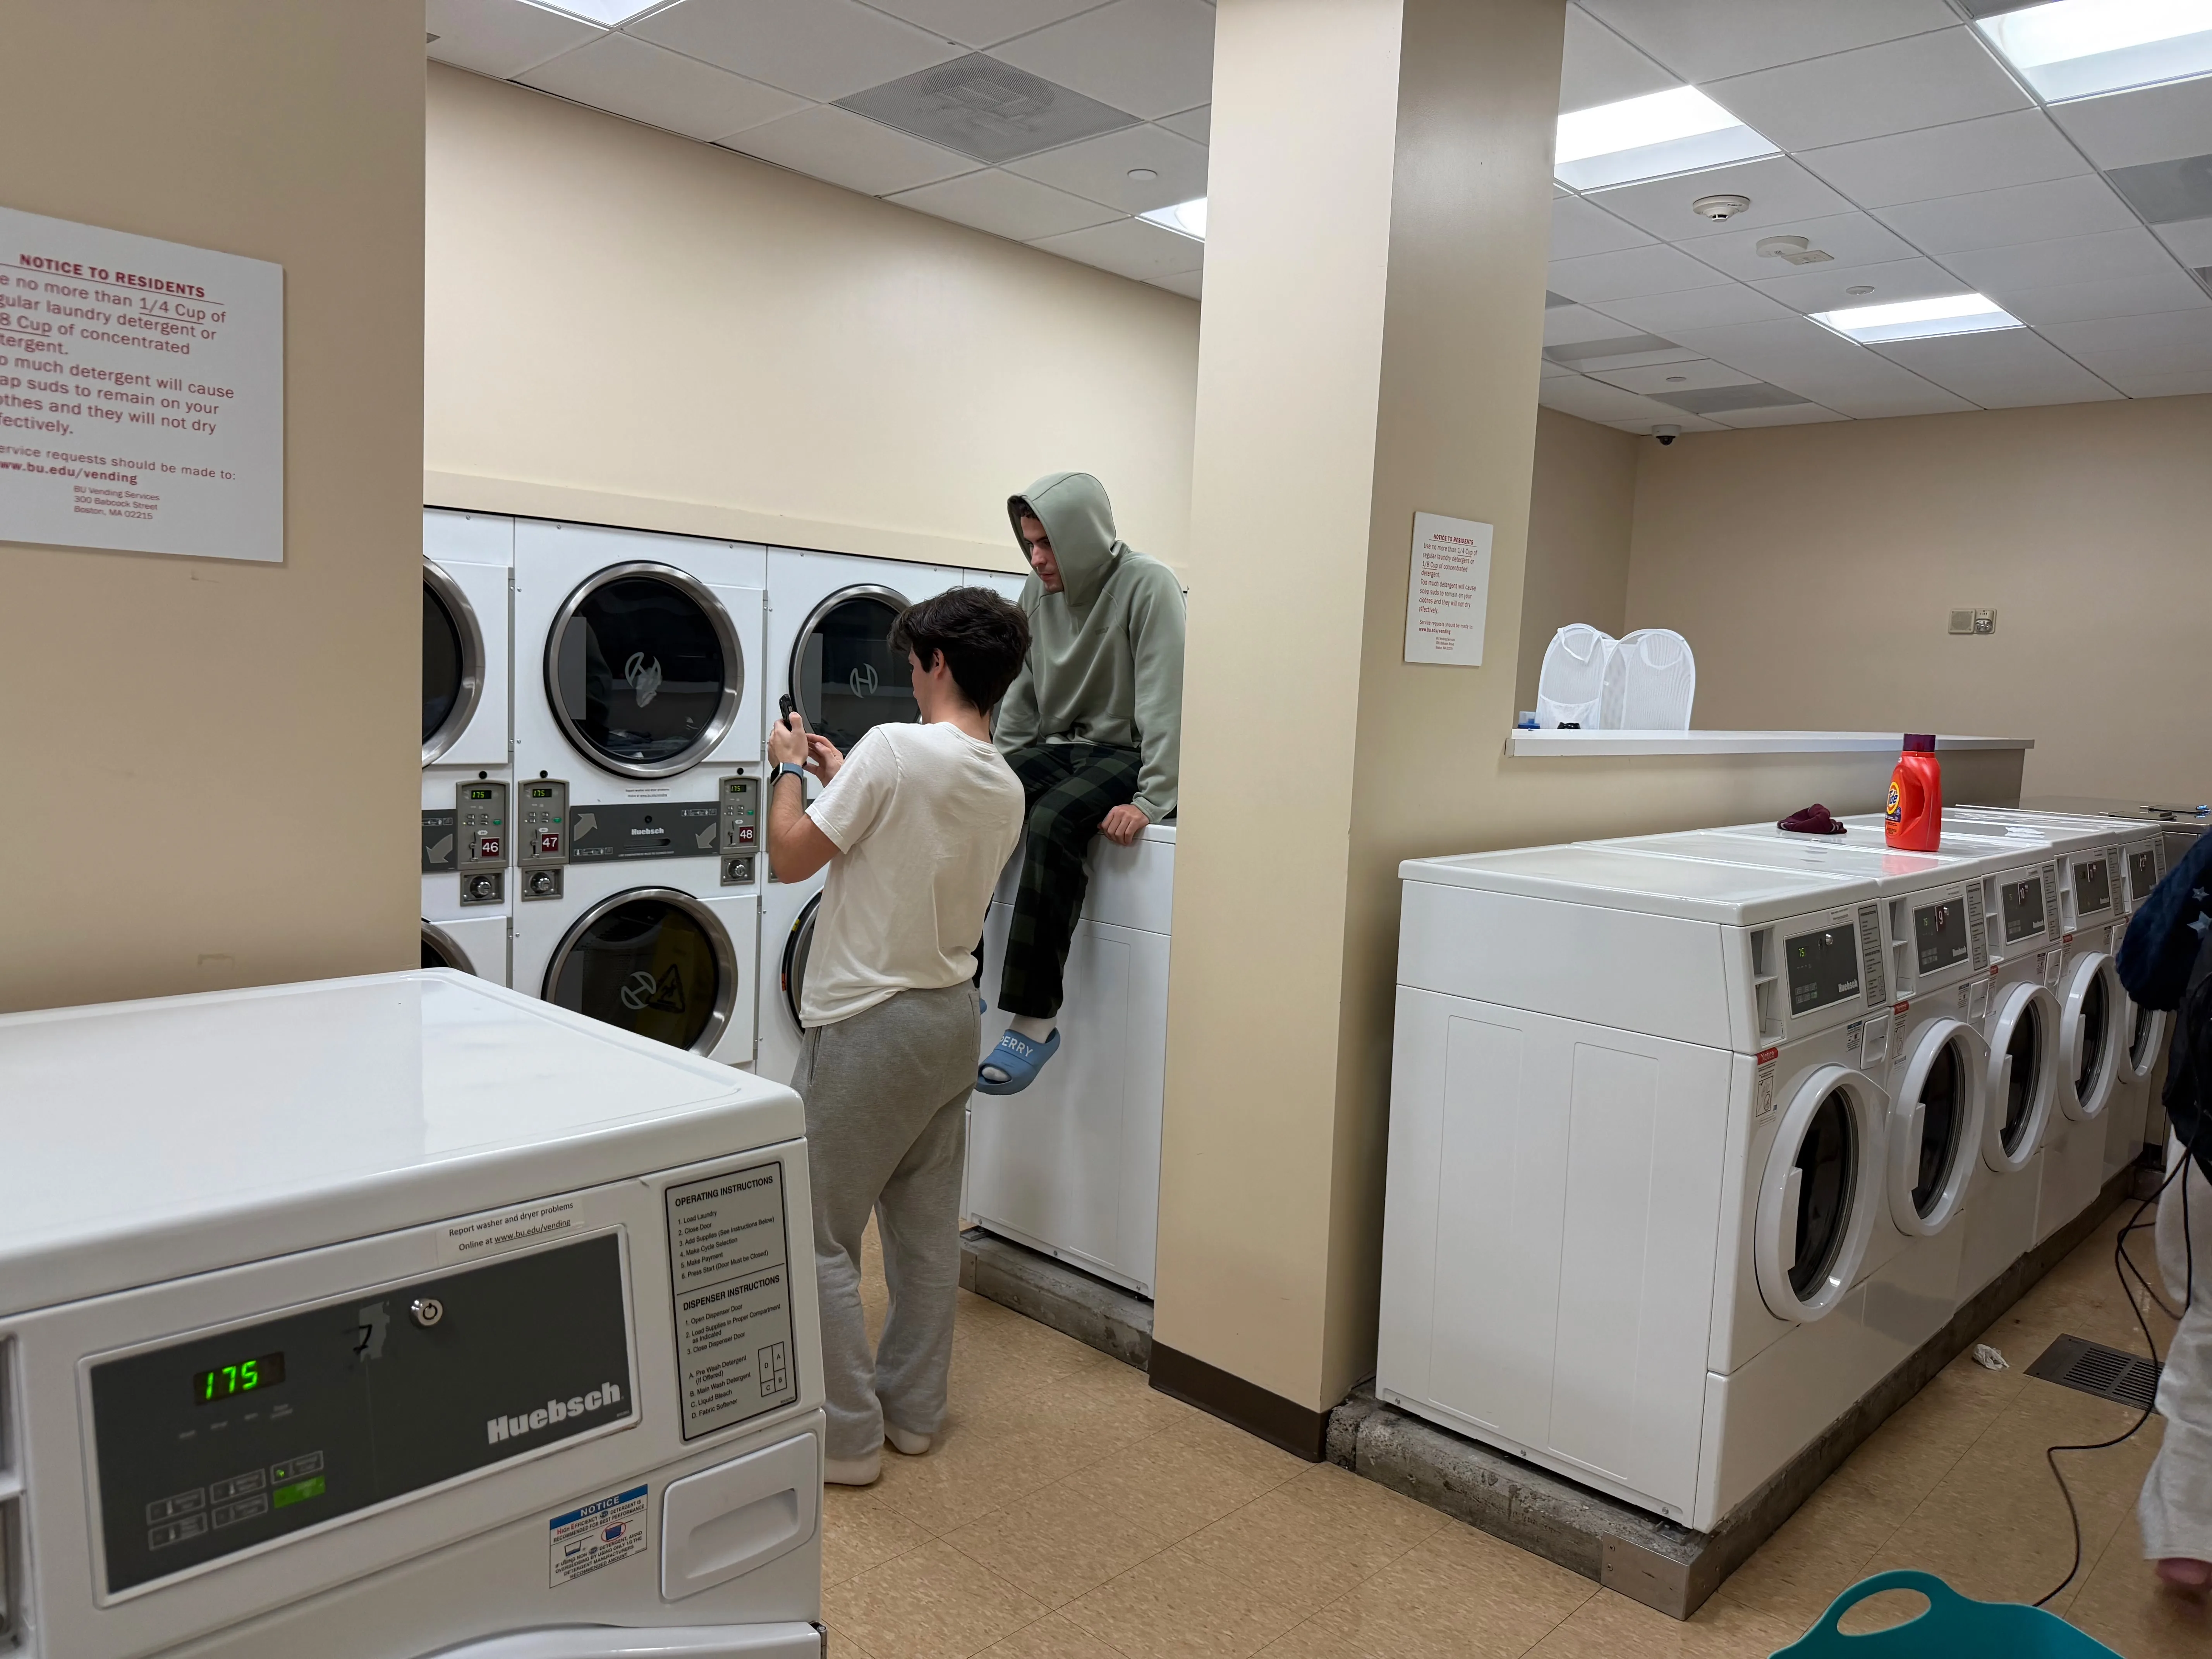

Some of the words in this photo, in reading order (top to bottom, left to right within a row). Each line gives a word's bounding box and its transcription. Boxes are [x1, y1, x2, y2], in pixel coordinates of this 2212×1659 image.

[20, 254, 82, 276] NOTICE
[88, 266, 109, 280] TO
[115, 271, 205, 298] RESIDENTS
[16, 278, 39, 290] no
[44, 283, 89, 300] more
[94, 290, 132, 307] than
[139, 297, 170, 313] 1/4
[175, 303, 206, 322] Cup
[211, 311, 227, 323] of
[46, 300, 112, 325] laundry
[117, 313, 196, 337] detergent
[201, 329, 217, 340] or
[17, 315, 52, 334] Cup
[57, 323, 75, 336] of
[80, 328, 190, 355] concentrated
[15, 358, 63, 374] much
[69, 364, 151, 387] detergent
[156, 378, 182, 391] will
[188, 383, 234, 399] cause
[27, 379, 69, 394] suds
[74, 384, 91, 397] to
[97, 389, 155, 406] remain
[160, 398, 180, 409] on
[185, 402, 219, 414] your
[48, 402, 81, 415] and
[87, 405, 123, 423] they
[128, 412, 155, 425] will
[161, 417, 187, 429] not
[192, 419, 216, 435] dry
[46, 451, 106, 465] requests
[111, 458, 156, 471] should
[161, 463, 176, 473] be
[181, 467, 216, 478] made
[220, 470, 235, 480] to:
[1453, 537, 1474, 545] RESIDENTS
[482, 842, 498, 852] 46
[542, 837, 558, 848] 47
[740, 830, 752, 838] 48
[2020, 887, 2025, 899] 10
[1938, 910, 1943, 925] 9
[675, 1189, 719, 1207] OPERATING
[720, 1176, 773, 1196] INSTRUCTIONS
[449, 1225, 474, 1237] Report
[476, 1219, 503, 1230] washer
[505, 1214, 519, 1224] and
[520, 1211, 539, 1220] dryer
[541, 1203, 573, 1216] problems
[683, 1214, 696, 1224] Load
[697, 1211, 717, 1220] Laundry
[685, 1237, 695, 1245] Add
[696, 1232, 717, 1242] Supplies
[718, 1229, 730, 1237] (See
[730, 1221, 758, 1233] Instructions
[758, 1216, 775, 1225] Below)
[459, 1240, 483, 1251] Online
[494, 1219, 570, 1243] www.bu.edu/vending
[701, 1243, 715, 1252] Cycle
[716, 1238, 738, 1248] Selection
[687, 1259, 701, 1267] Make
[701, 1252, 723, 1263] Payment
[687, 1269, 702, 1278] Press
[703, 1265, 715, 1273] Start
[716, 1261, 730, 1271] (Door
[730, 1257, 742, 1266] Must
[750, 1250, 768, 1260] Closed)
[683, 1291, 726, 1311] DISPENSER
[727, 1274, 780, 1297] INSTRUCTIONS
[691, 1316, 705, 1324] Open
[706, 1308, 730, 1320] Dispenser
[693, 1344, 708, 1353] Close
[708, 1336, 733, 1348] Dispenser
[733, 1332, 745, 1340] Door
[206, 1360, 259, 1400] 175
[698, 1395, 714, 1406] Liquid
[714, 1389, 732, 1400] Bleach
[699, 1407, 715, 1416] Fabric
[716, 1399, 737, 1410] Softener
[487, 1381, 620, 1445] Huebsch
[580, 1496, 619, 1517] NOTICE
